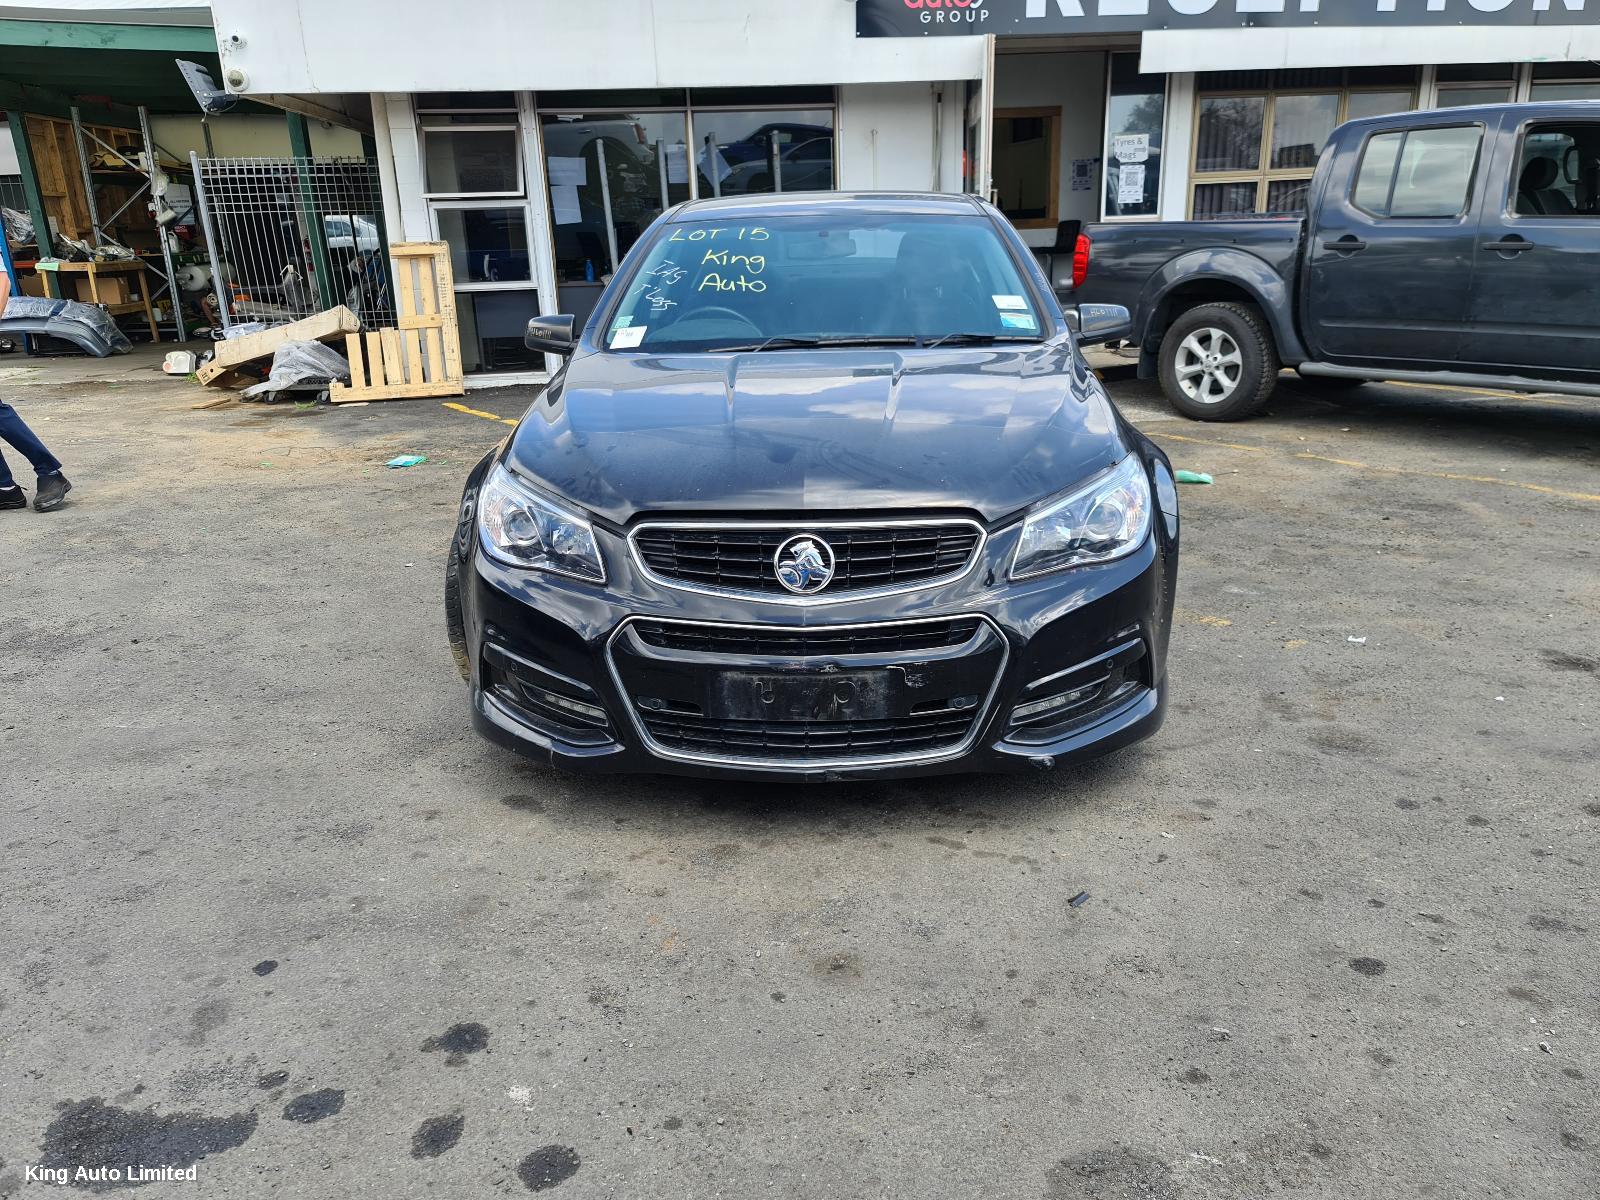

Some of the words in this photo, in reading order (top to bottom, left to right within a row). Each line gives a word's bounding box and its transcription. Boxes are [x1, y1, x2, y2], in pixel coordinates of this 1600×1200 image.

[919, 9, 990, 24] GROUP
[1116, 138, 1136, 147] Tyres
[668, 228, 728, 242] LOT
[738, 227, 770, 241] 15
[700, 249, 766, 275] King
[698, 273, 767, 293] Auto
